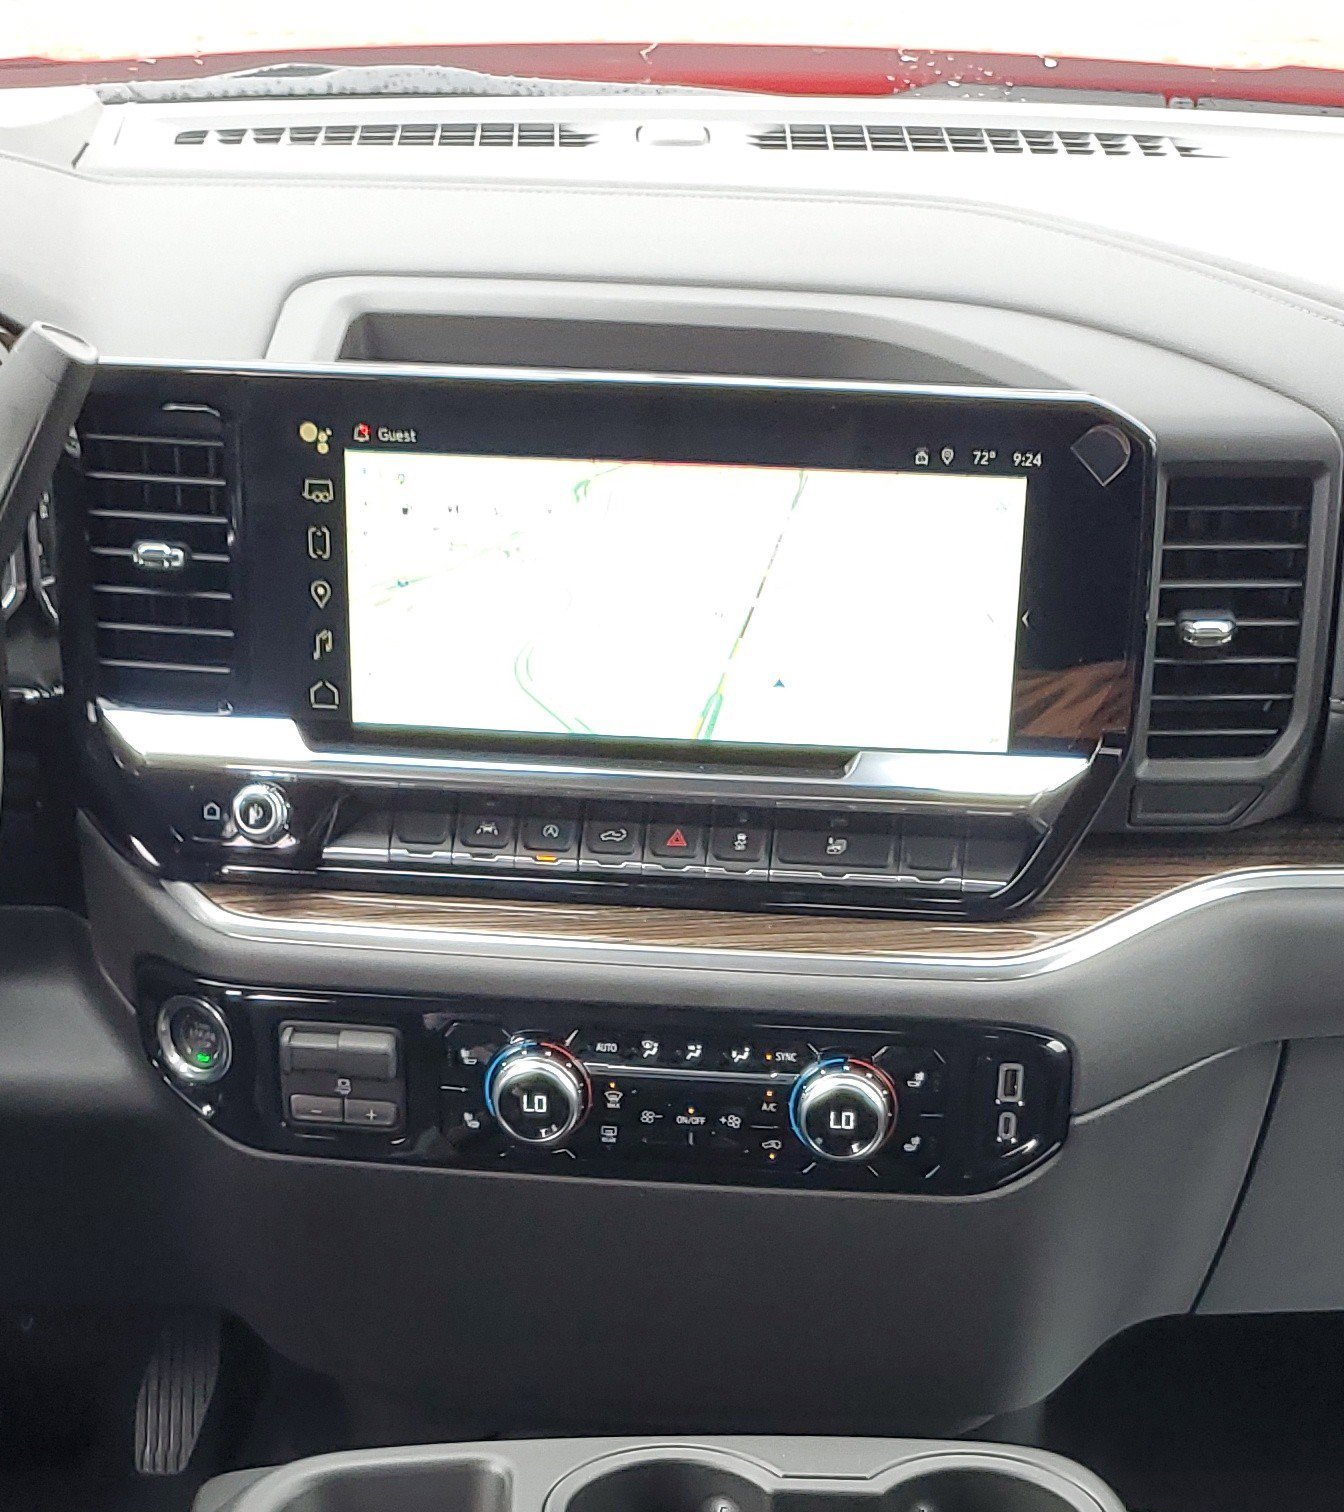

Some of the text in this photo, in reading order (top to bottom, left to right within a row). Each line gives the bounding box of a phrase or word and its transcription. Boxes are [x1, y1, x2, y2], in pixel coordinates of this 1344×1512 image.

[377, 426, 417, 443] Guest
[1013, 451, 1043, 467] 9:24
[595, 1042, 618, 1053] AUTO
[775, 1052, 798, 1063] SYNC
[761, 1103, 778, 1113] A/C
[676, 1115, 706, 1126] ON/OFF
